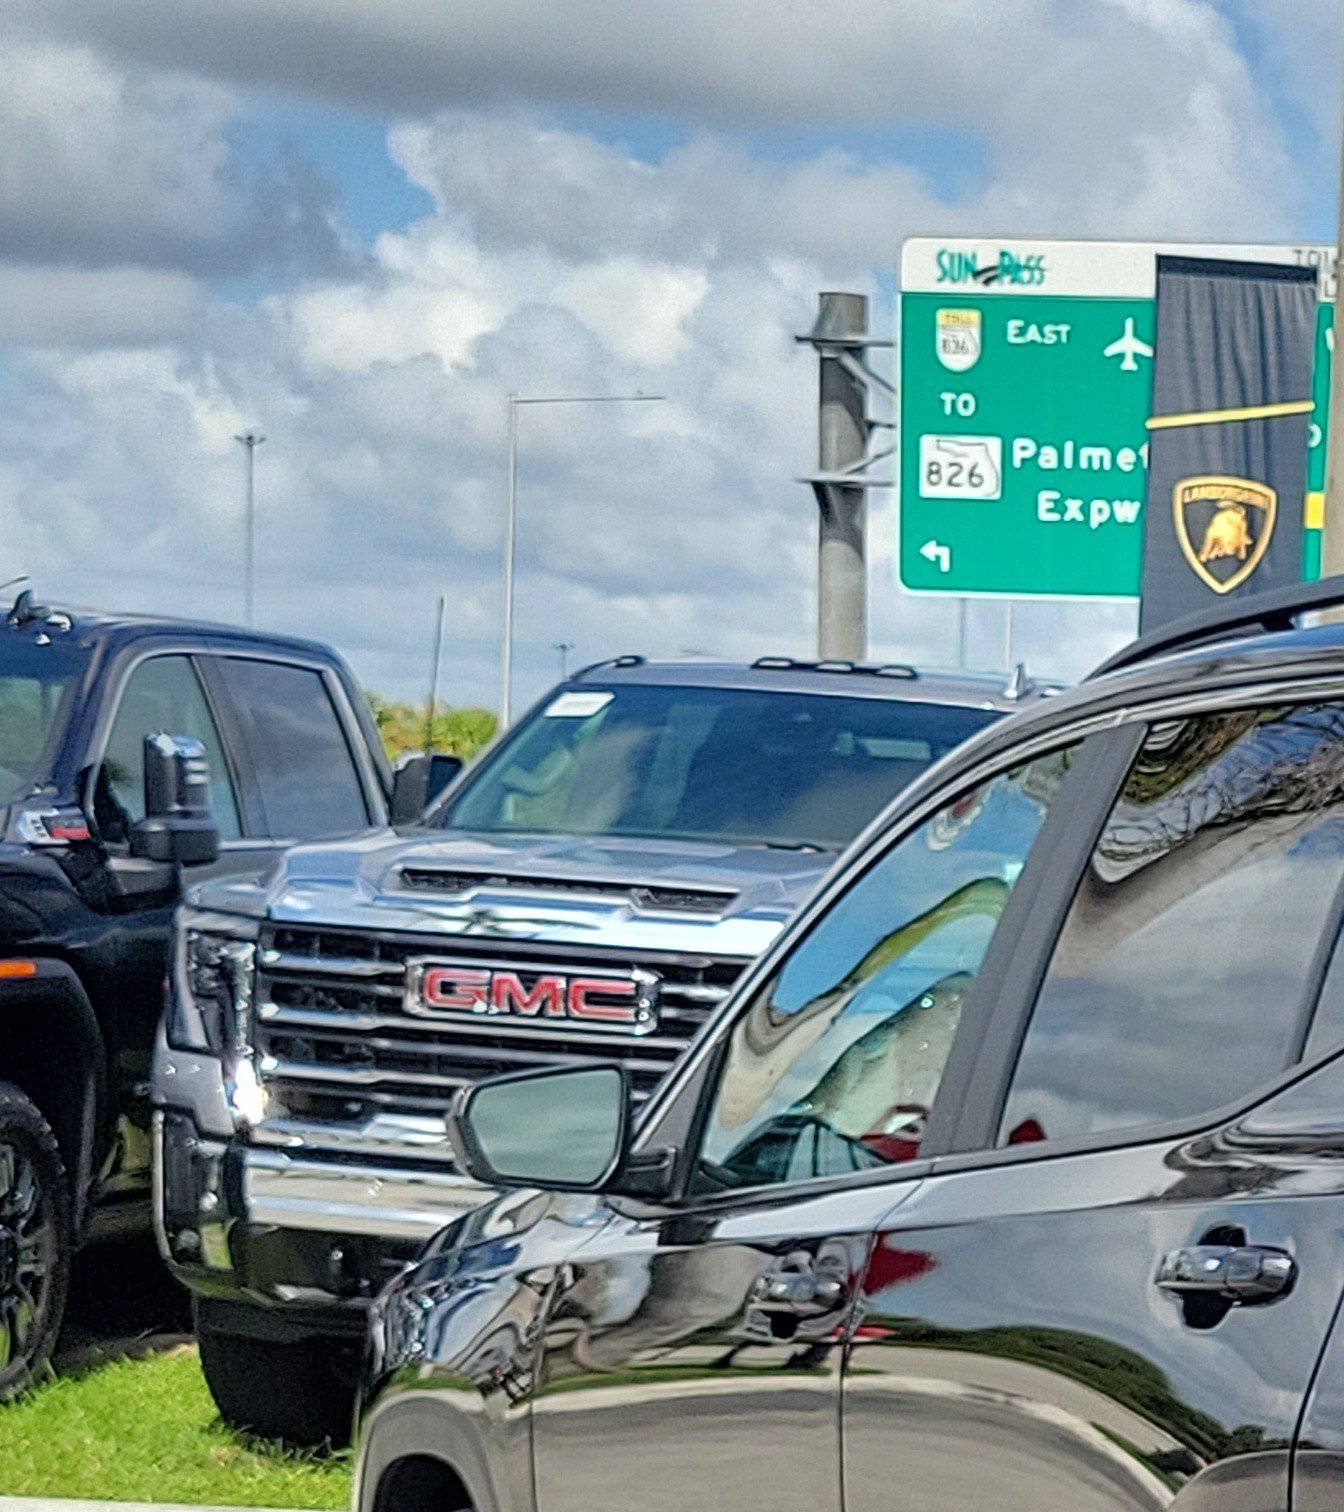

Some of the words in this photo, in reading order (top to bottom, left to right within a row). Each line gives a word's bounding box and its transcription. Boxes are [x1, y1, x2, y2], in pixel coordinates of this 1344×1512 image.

[1006, 319, 1071, 344] EAST
[940, 392, 976, 416] TO
[927, 461, 984, 488] 826
[1037, 490, 1141, 530] Expw
[423, 967, 637, 1022] GMC
